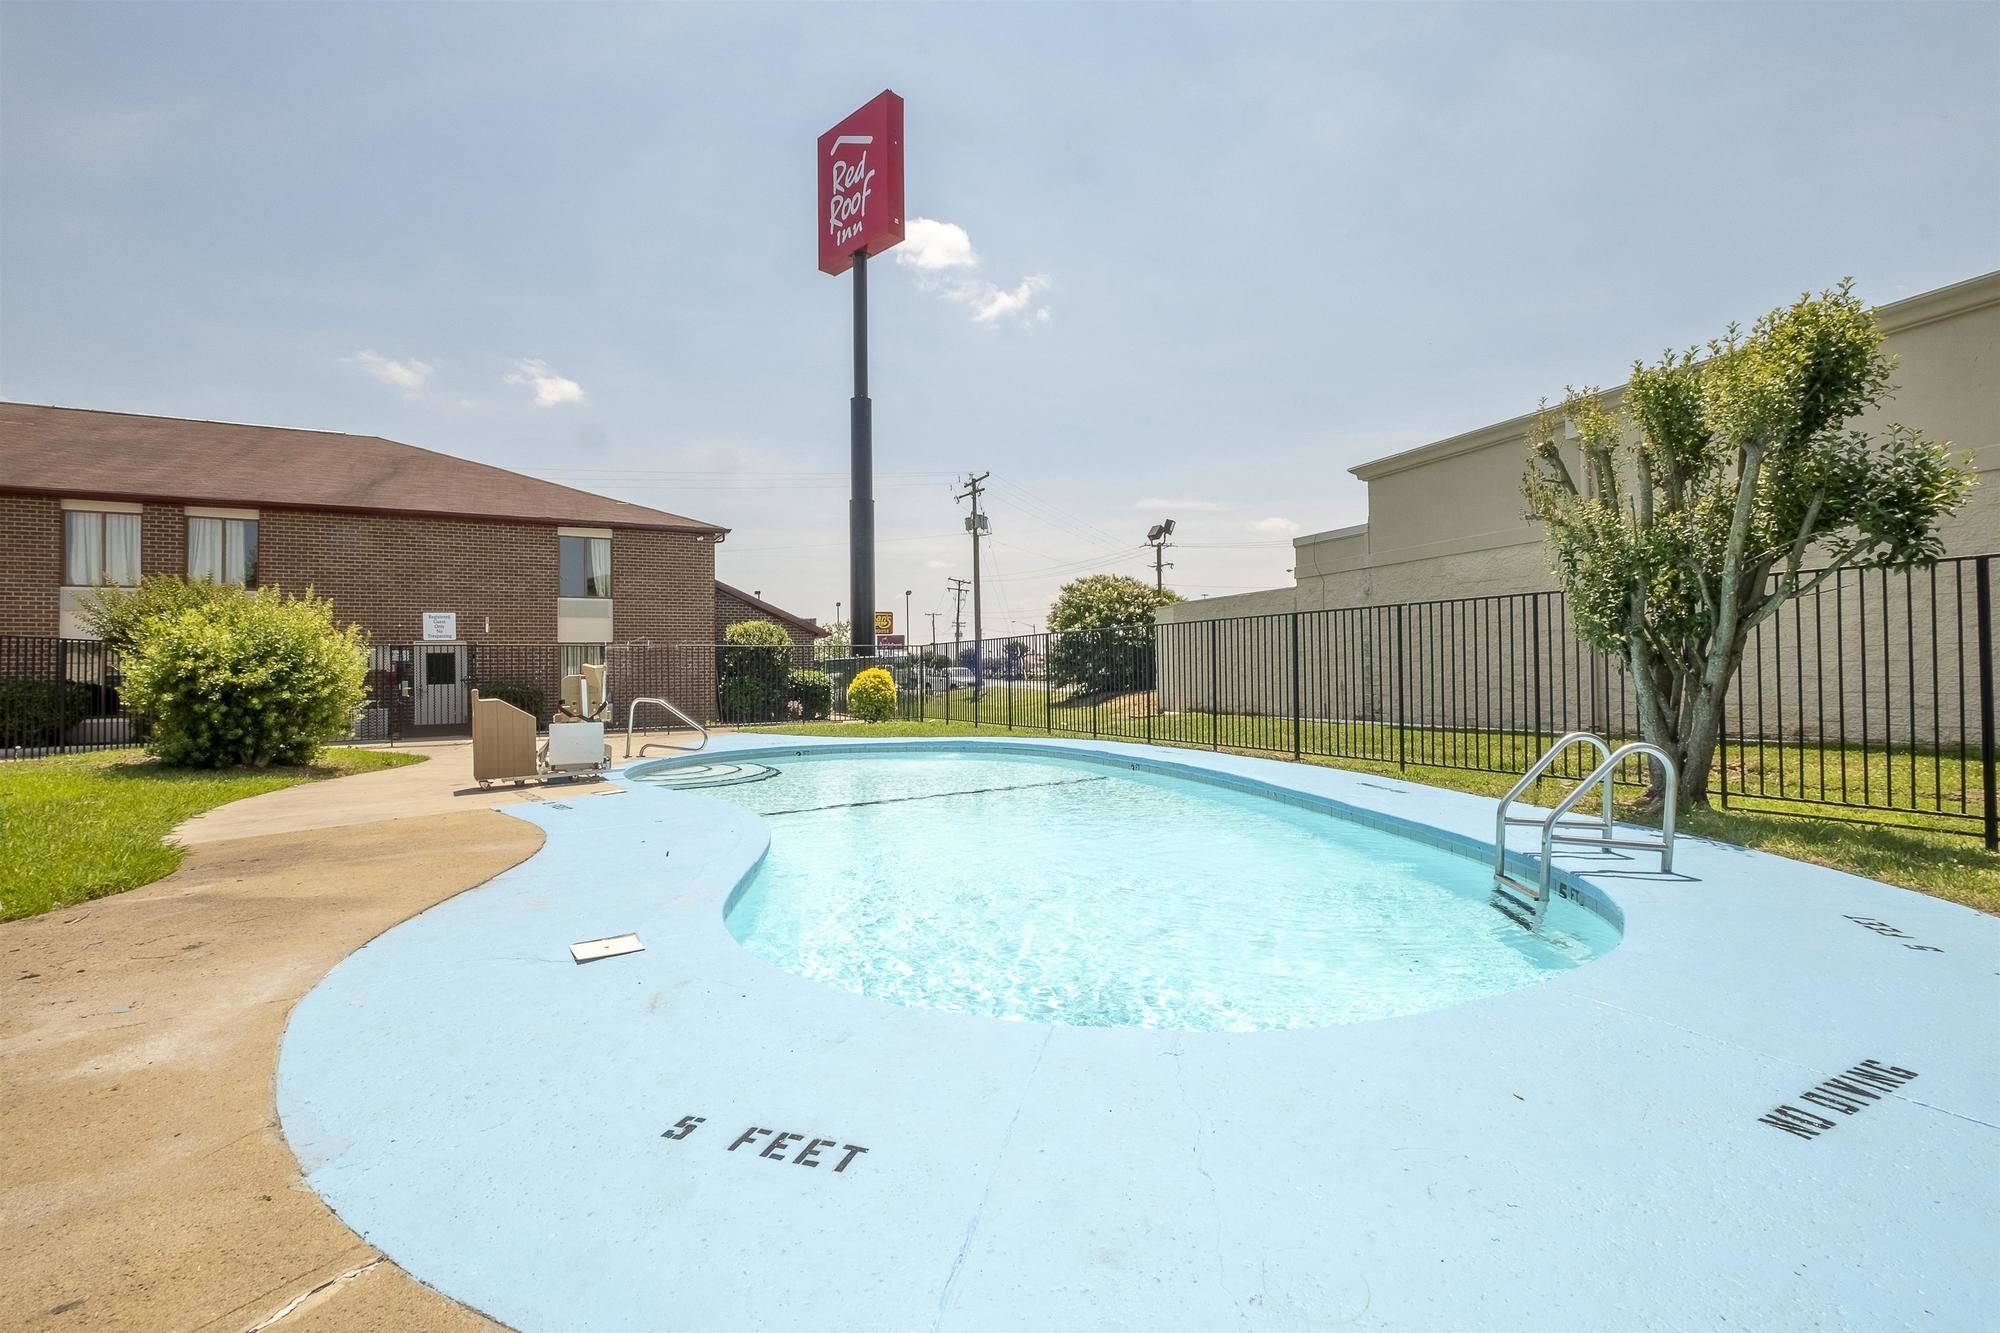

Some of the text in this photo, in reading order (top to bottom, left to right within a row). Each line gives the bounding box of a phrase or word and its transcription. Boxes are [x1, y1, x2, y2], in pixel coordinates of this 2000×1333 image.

[832, 150, 867, 195] Red
[830, 169, 875, 235] Roof
[1559, 882, 1568, 900] 5
[1757, 1059, 1919, 1140] NO DIVING
[660, 1115, 870, 1173] 5 FEET
